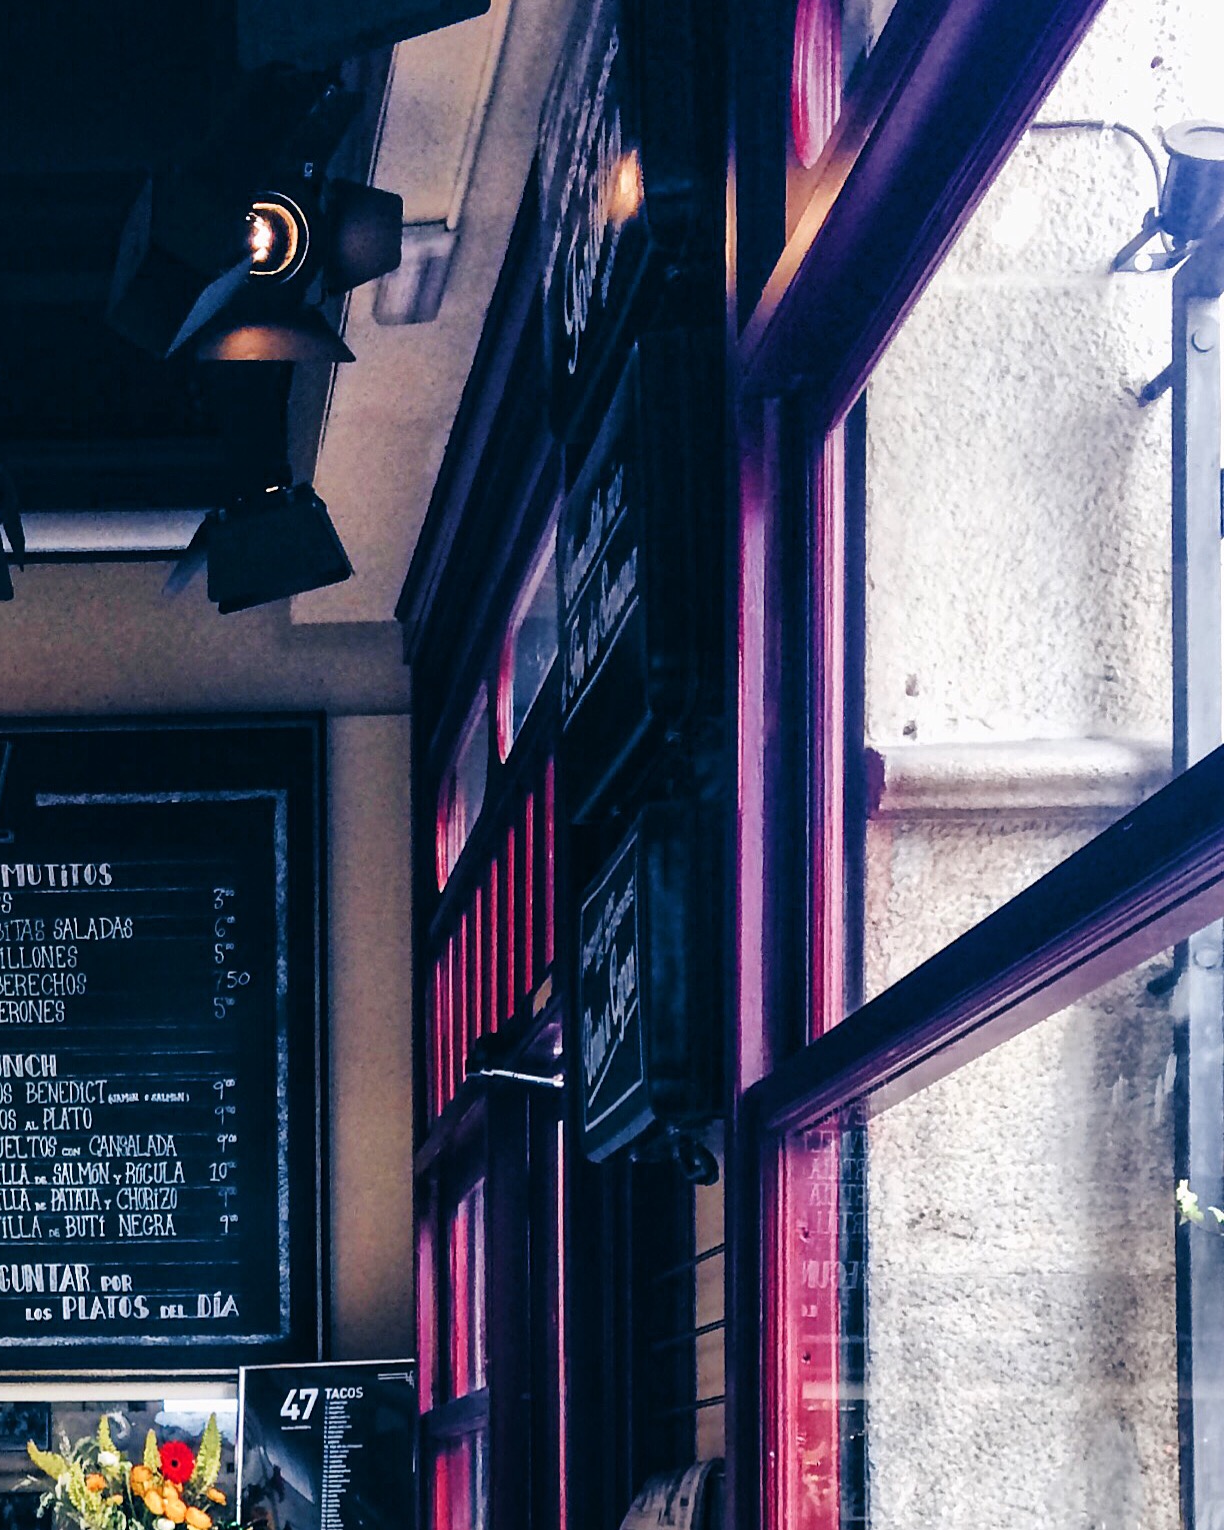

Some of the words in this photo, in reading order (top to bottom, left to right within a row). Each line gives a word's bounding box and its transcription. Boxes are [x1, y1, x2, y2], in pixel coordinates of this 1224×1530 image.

[54, 917, 133, 940] SALADAS
[26, 1079, 107, 1105] BENEDICT
[43, 1107, 92, 1130] PLATO
[51, 1188, 100, 1212] PATATA
[116, 1188, 177, 1211] CHORIZO
[119, 1214, 176, 1237] NEGRA
[100, 1275, 132, 1292] POR
[26, 1307, 52, 1321] LOS
[62, 1295, 149, 1320] PLATOS
[160, 1305, 187, 1318] DEL
[197, 1291, 239, 1318] DÍA
[280, 1388, 319, 1421] 47
[325, 1387, 364, 1400] TACOS
